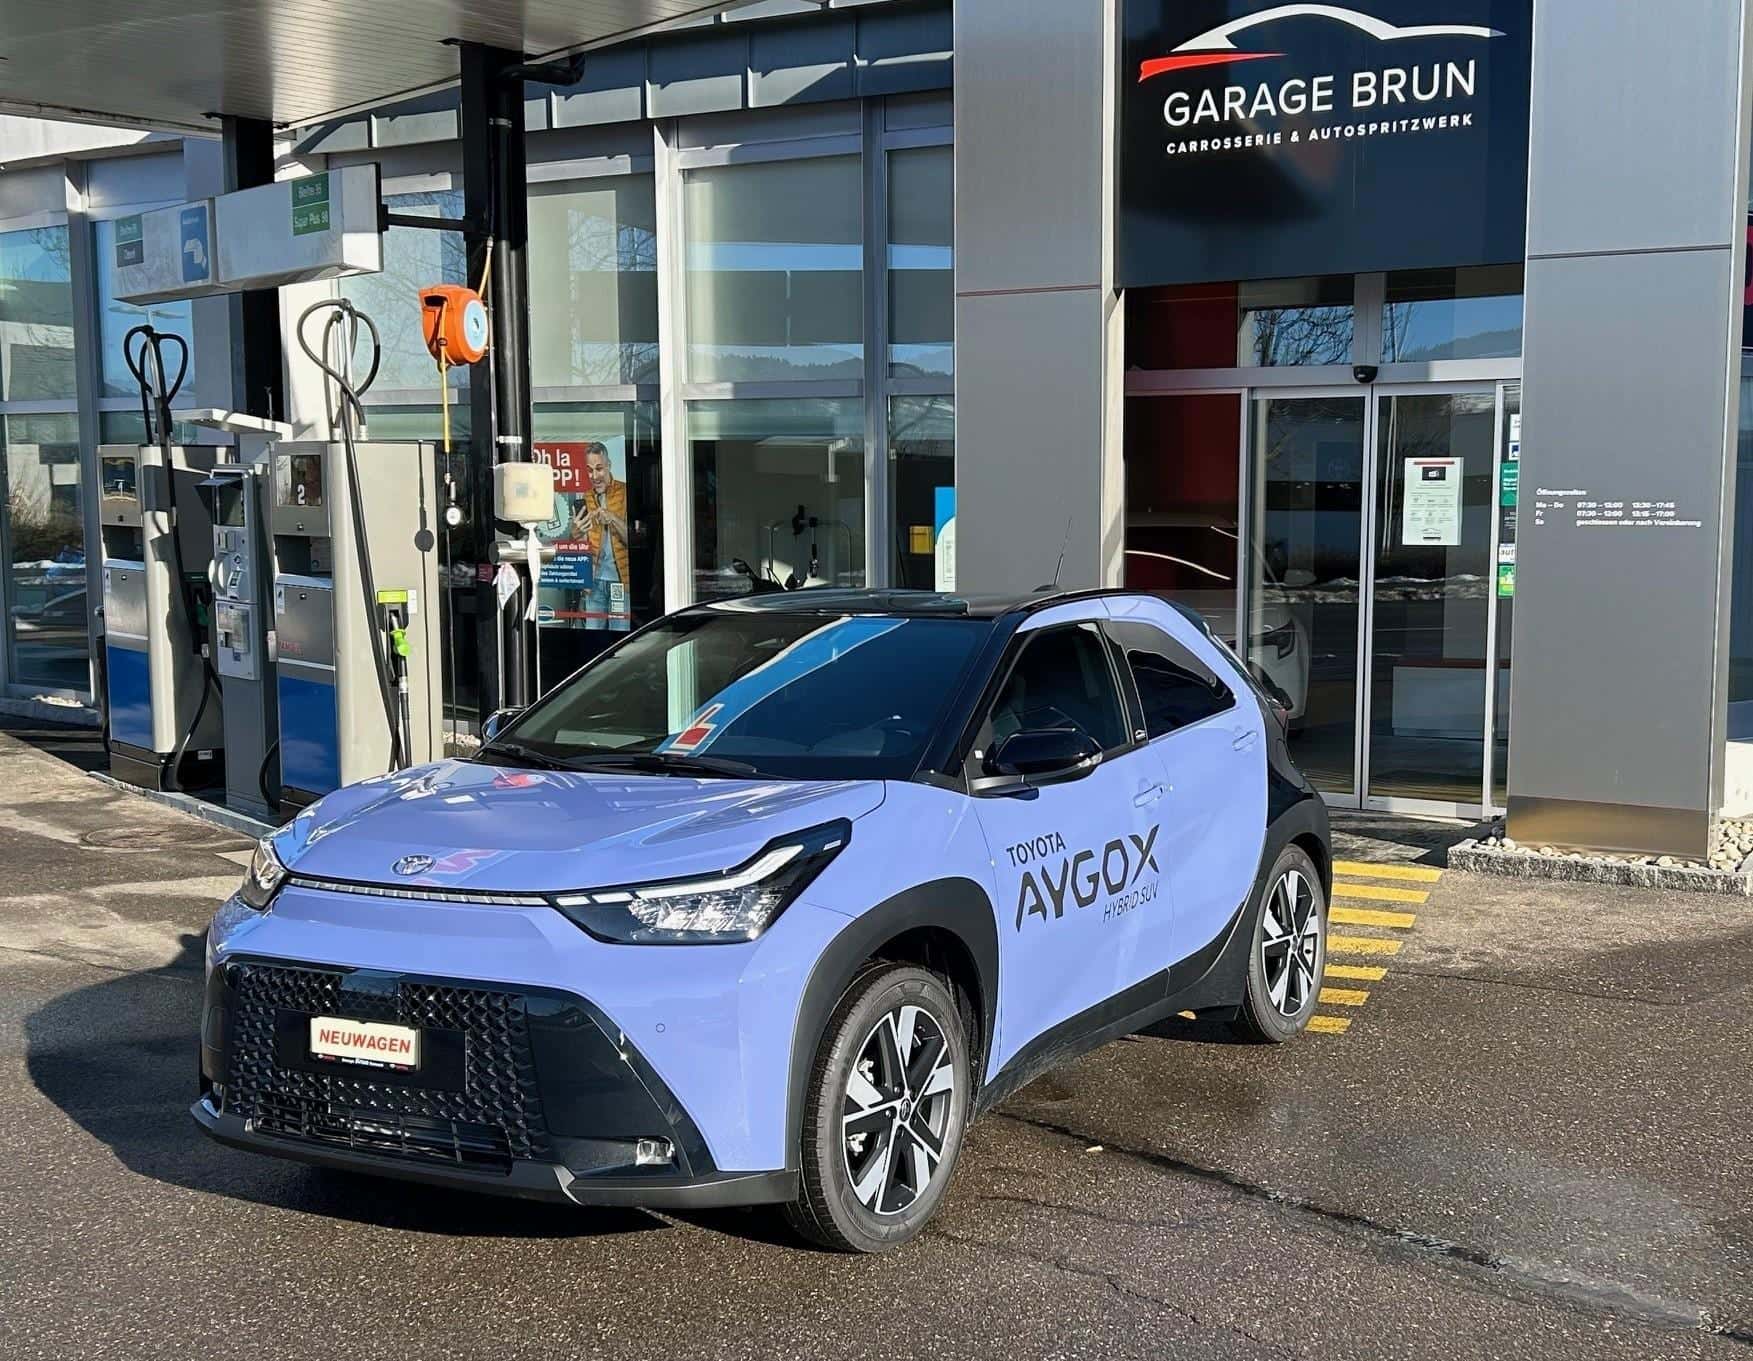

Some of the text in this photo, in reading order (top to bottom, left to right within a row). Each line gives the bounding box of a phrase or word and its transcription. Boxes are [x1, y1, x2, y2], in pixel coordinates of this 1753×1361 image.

[1163, 59, 1475, 127] GARAGE BRUN
[1166, 113, 1473, 154] CARROSSERIE & AUTOSPRITZWERK
[556, 448, 570, 467] la
[552, 468, 580, 487] PP!
[297, 484, 306, 505] 2
[1006, 831, 1067, 867] TOYOTA
[319, 1028, 411, 1053] NEUWAGEN
